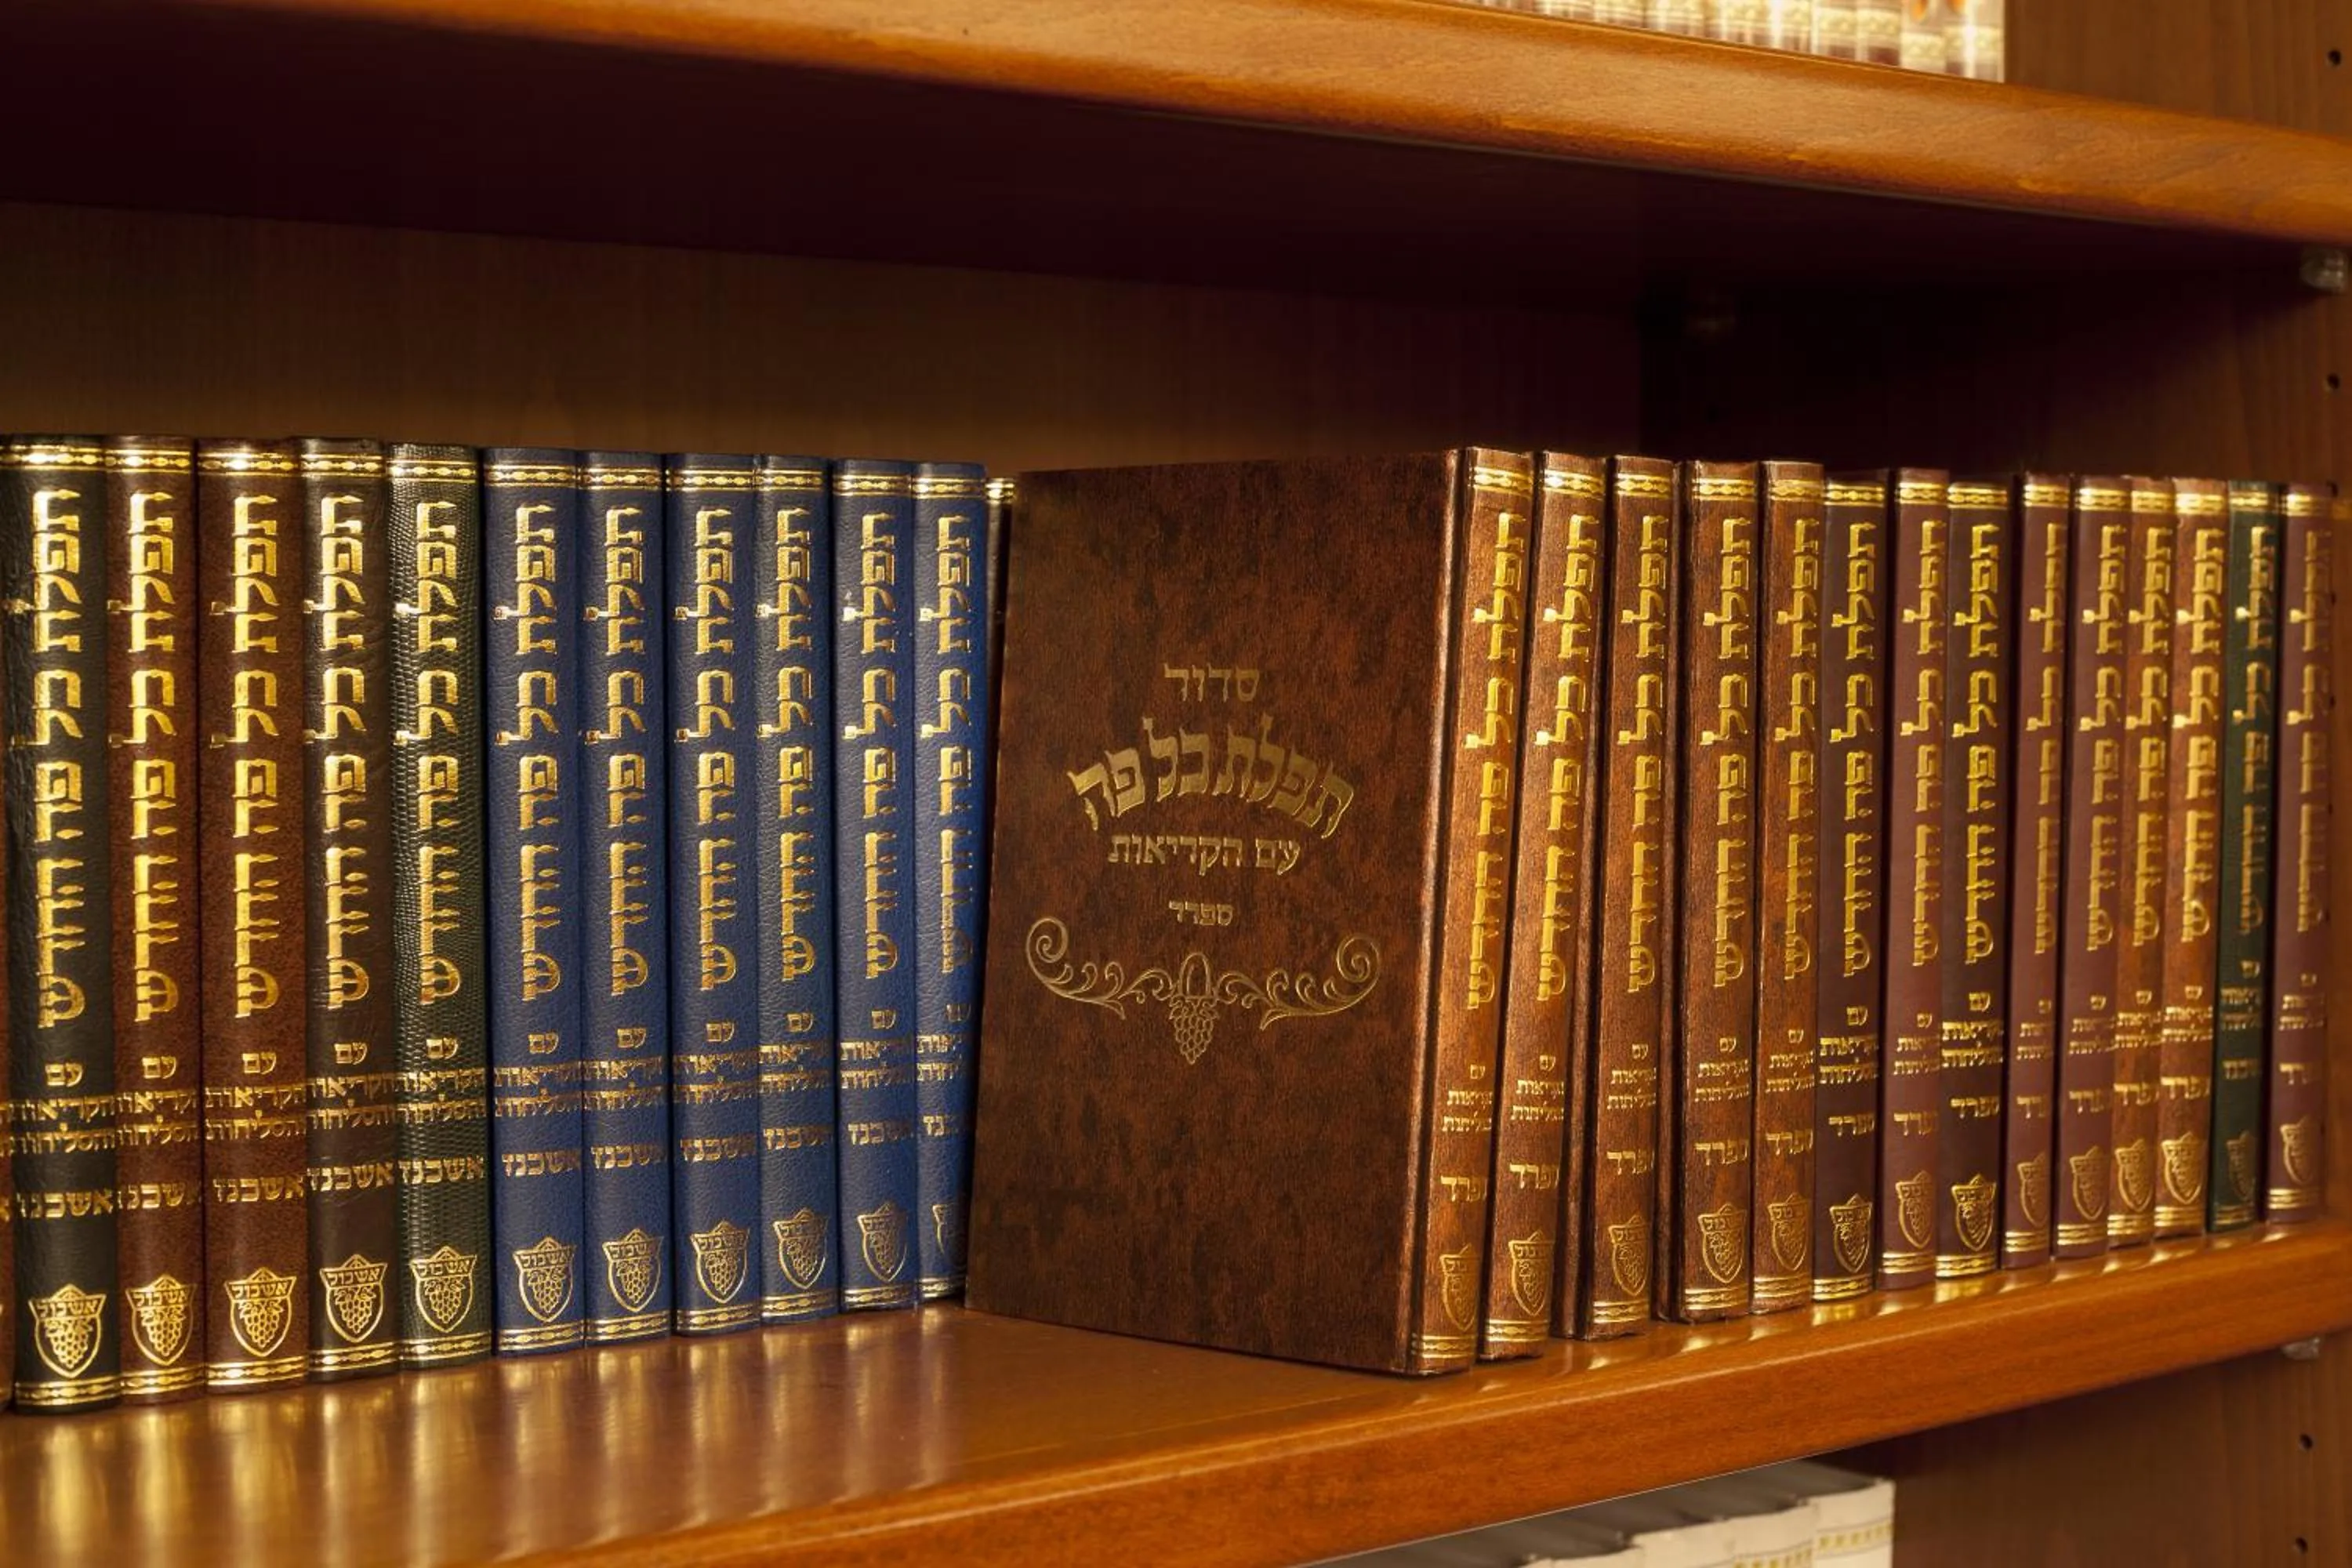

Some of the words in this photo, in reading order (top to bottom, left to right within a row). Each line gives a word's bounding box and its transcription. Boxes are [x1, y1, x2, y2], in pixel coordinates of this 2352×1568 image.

[2, 489, 81, 652] תפלת
[107, 493, 175, 652] תפלת
[211, 495, 278, 652] תפלת
[304, 495, 364, 652] תפלת
[395, 502, 457, 652] תפלת
[492, 505, 556, 655] תפלת
[583, 506, 644, 655] תפלת
[675, 508, 733, 655] תפלת
[756, 508, 811, 652] תפלת
[843, 512, 895, 654] תפלת
[11, 670, 83, 746] כל
[108, 670, 176, 748] כל
[210, 670, 278, 749] כל
[304, 667, 366, 745] כל
[394, 670, 458, 746] כל
[495, 670, 558, 745] כל
[585, 670, 646, 743] כל
[676, 669, 735, 742] כל
[757, 666, 812, 738] כל
[844, 668, 896, 739] כל
[1163, 662, 1261, 702] סדור
[325, 755, 367, 833] פה
[418, 755, 459, 832] פה
[519, 753, 559, 829] פה
[608, 753, 646, 829] פה
[698, 751, 735, 825] פה
[779, 746, 813, 818] פה
[864, 747, 896, 818] פה
[1067, 747, 1145, 831] פה
[1142, 716, 1212, 802] כל
[1213, 713, 1355, 839] תפלת
[34, 762, 84, 842] פה
[132, 759, 176, 839] פה
[234, 759, 279, 840] פה
[1107, 833, 1243, 877] הקריאות
[1254, 837, 1301, 877] עם
[1168, 900, 1235, 926] ספרד
[45, 1063, 83, 1087] עם
[142, 1056, 177, 1079] עם
[241, 1051, 277, 1074] עם
[334, 1042, 368, 1065] עם
[426, 1036, 459, 1059] עם
[16, 1188, 114, 1218] אשכנז
[118, 1182, 201, 1210] שכנז
[213, 1176, 303, 1203] אשכנז
[307, 1163, 394, 1192] אשכנז
[397, 1155, 484, 1185] אשכנז
[232, 1282, 289, 1298] אשכול
[326, 1268, 379, 1286] אשכול
[416, 1260, 470, 1276] אשכול
[37, 1299, 97, 1317] אשכול
